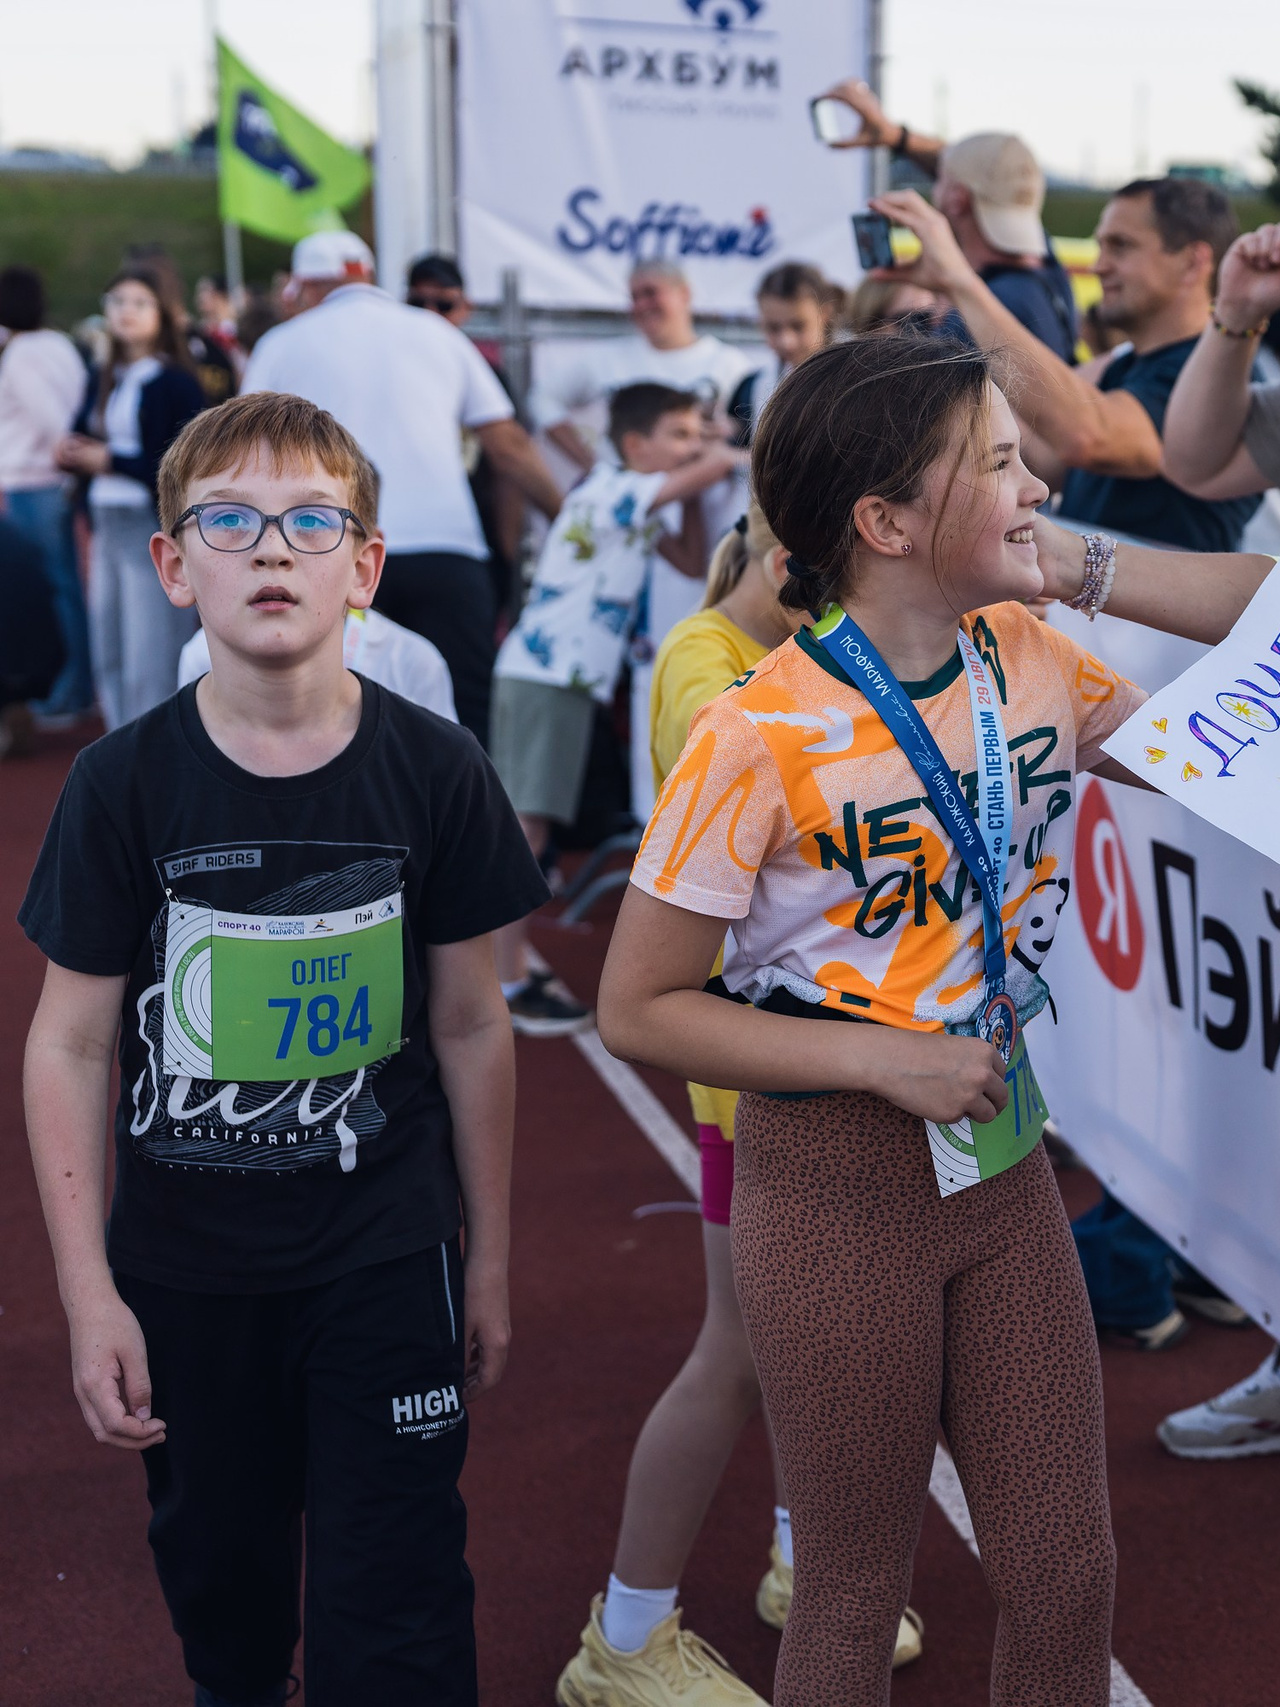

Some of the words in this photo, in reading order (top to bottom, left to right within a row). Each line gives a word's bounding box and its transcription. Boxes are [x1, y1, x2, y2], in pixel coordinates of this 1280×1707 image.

[560, 45, 780, 89] АРХБУМ
[840, 635, 891, 697] МАРАФОН
[976, 686, 991, 705] 29
[980, 711, 1003, 776] ПЕРВЫМ
[932, 771, 975, 847] КАЛУЖСКИЙ
[987, 780, 1005, 830] СТАНЬ
[205, 853, 255, 868] RIDERS
[993, 837, 1003, 855] 40
[217, 920, 247, 931] СПОРТ
[249, 924, 261, 932] 40
[268, 927, 305, 936] МАРАФОН
[355, 911, 373, 924] Пэй
[291, 952, 352, 986] ОЛЕГ
[267, 984, 373, 1060] 784
[173, 1126, 323, 1146] CALIFORNIA
[392, 1385, 459, 1424] HIGH
